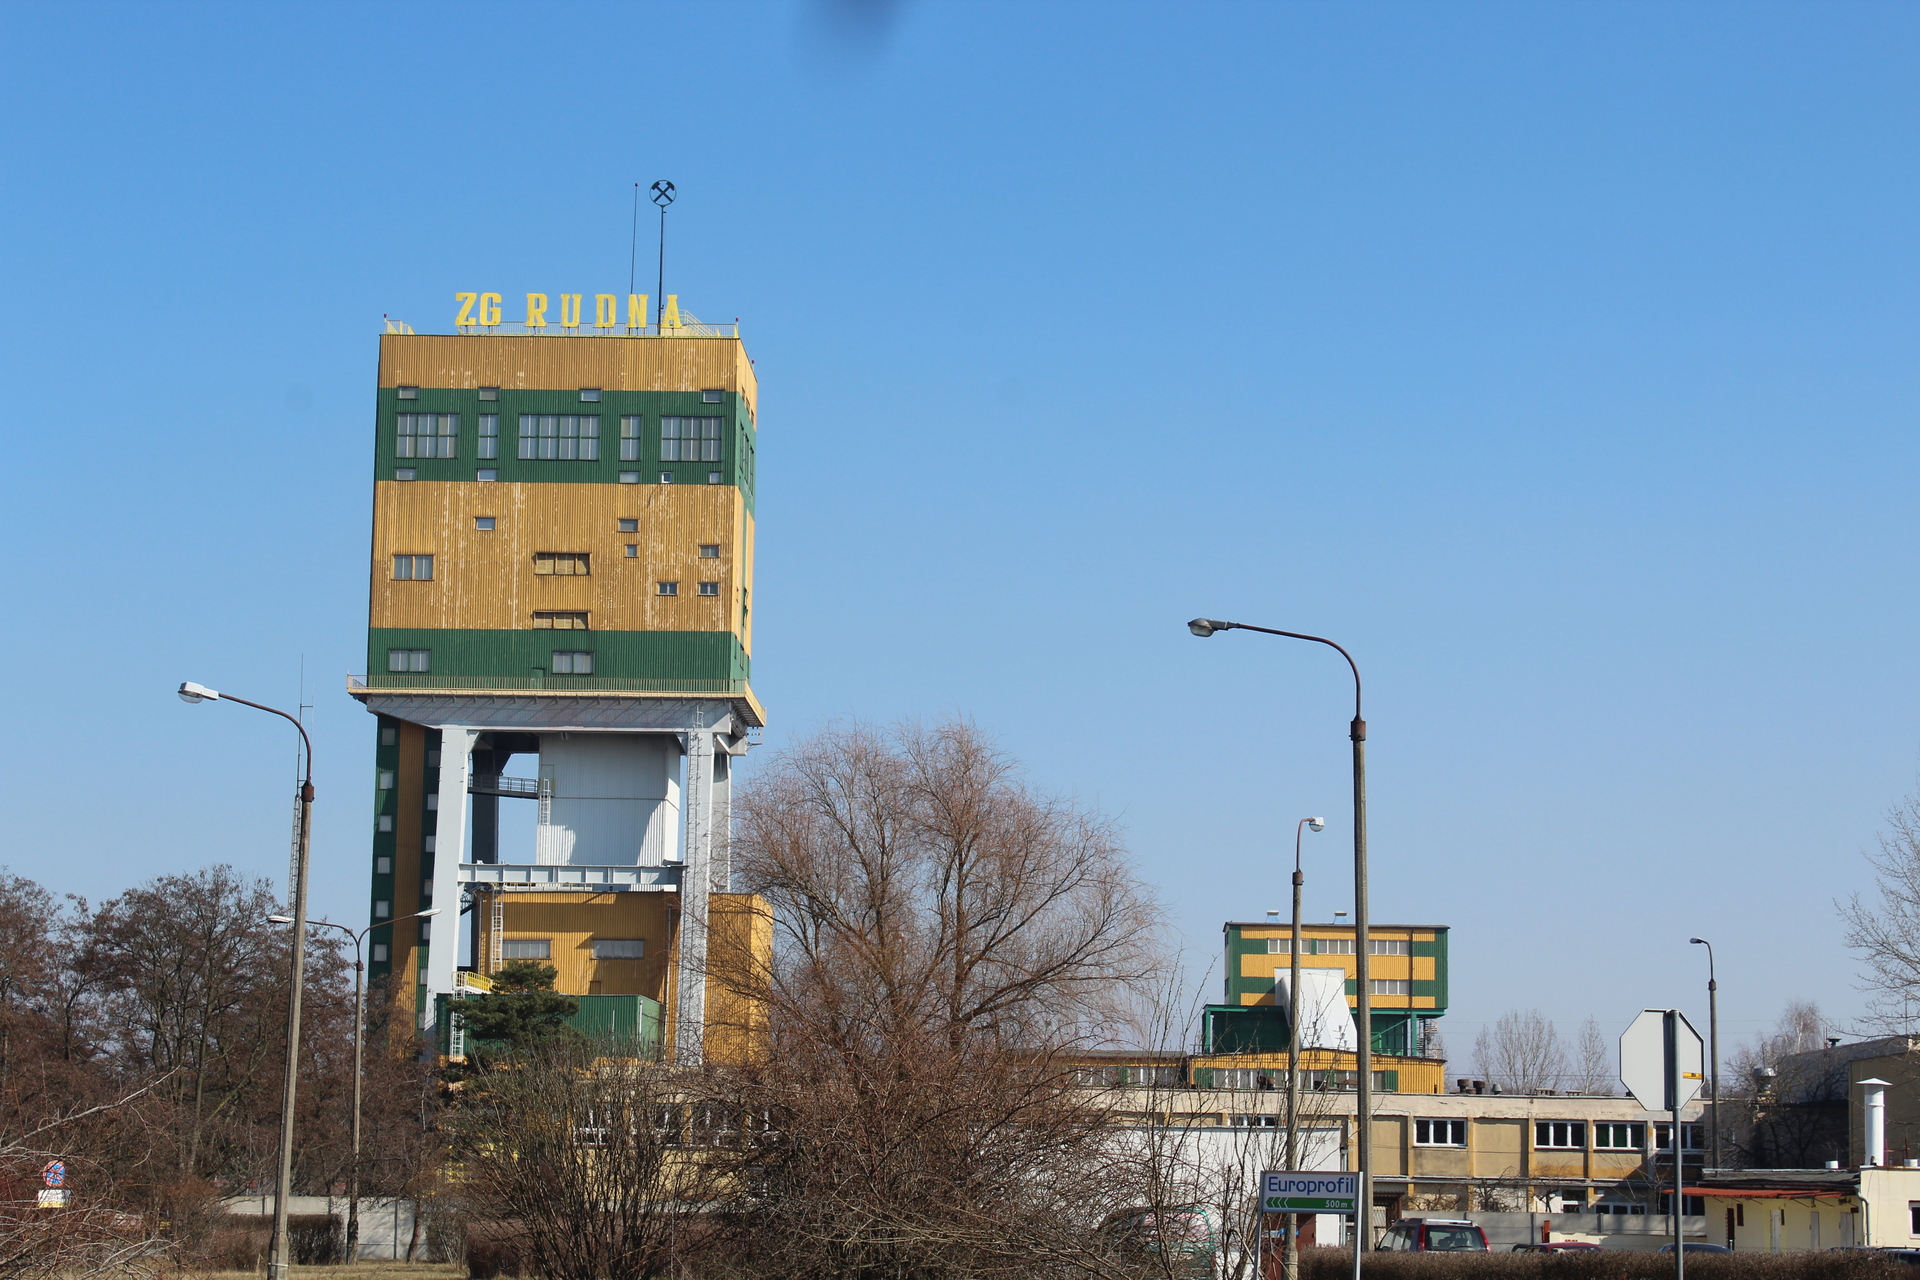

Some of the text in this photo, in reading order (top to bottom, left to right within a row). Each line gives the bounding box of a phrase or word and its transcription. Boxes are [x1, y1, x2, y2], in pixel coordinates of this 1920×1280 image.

[455, 292, 682, 329] ZG RUDNA
[1268, 1176, 1354, 1196] Europrofil
[1325, 1200, 1340, 1208] 500
